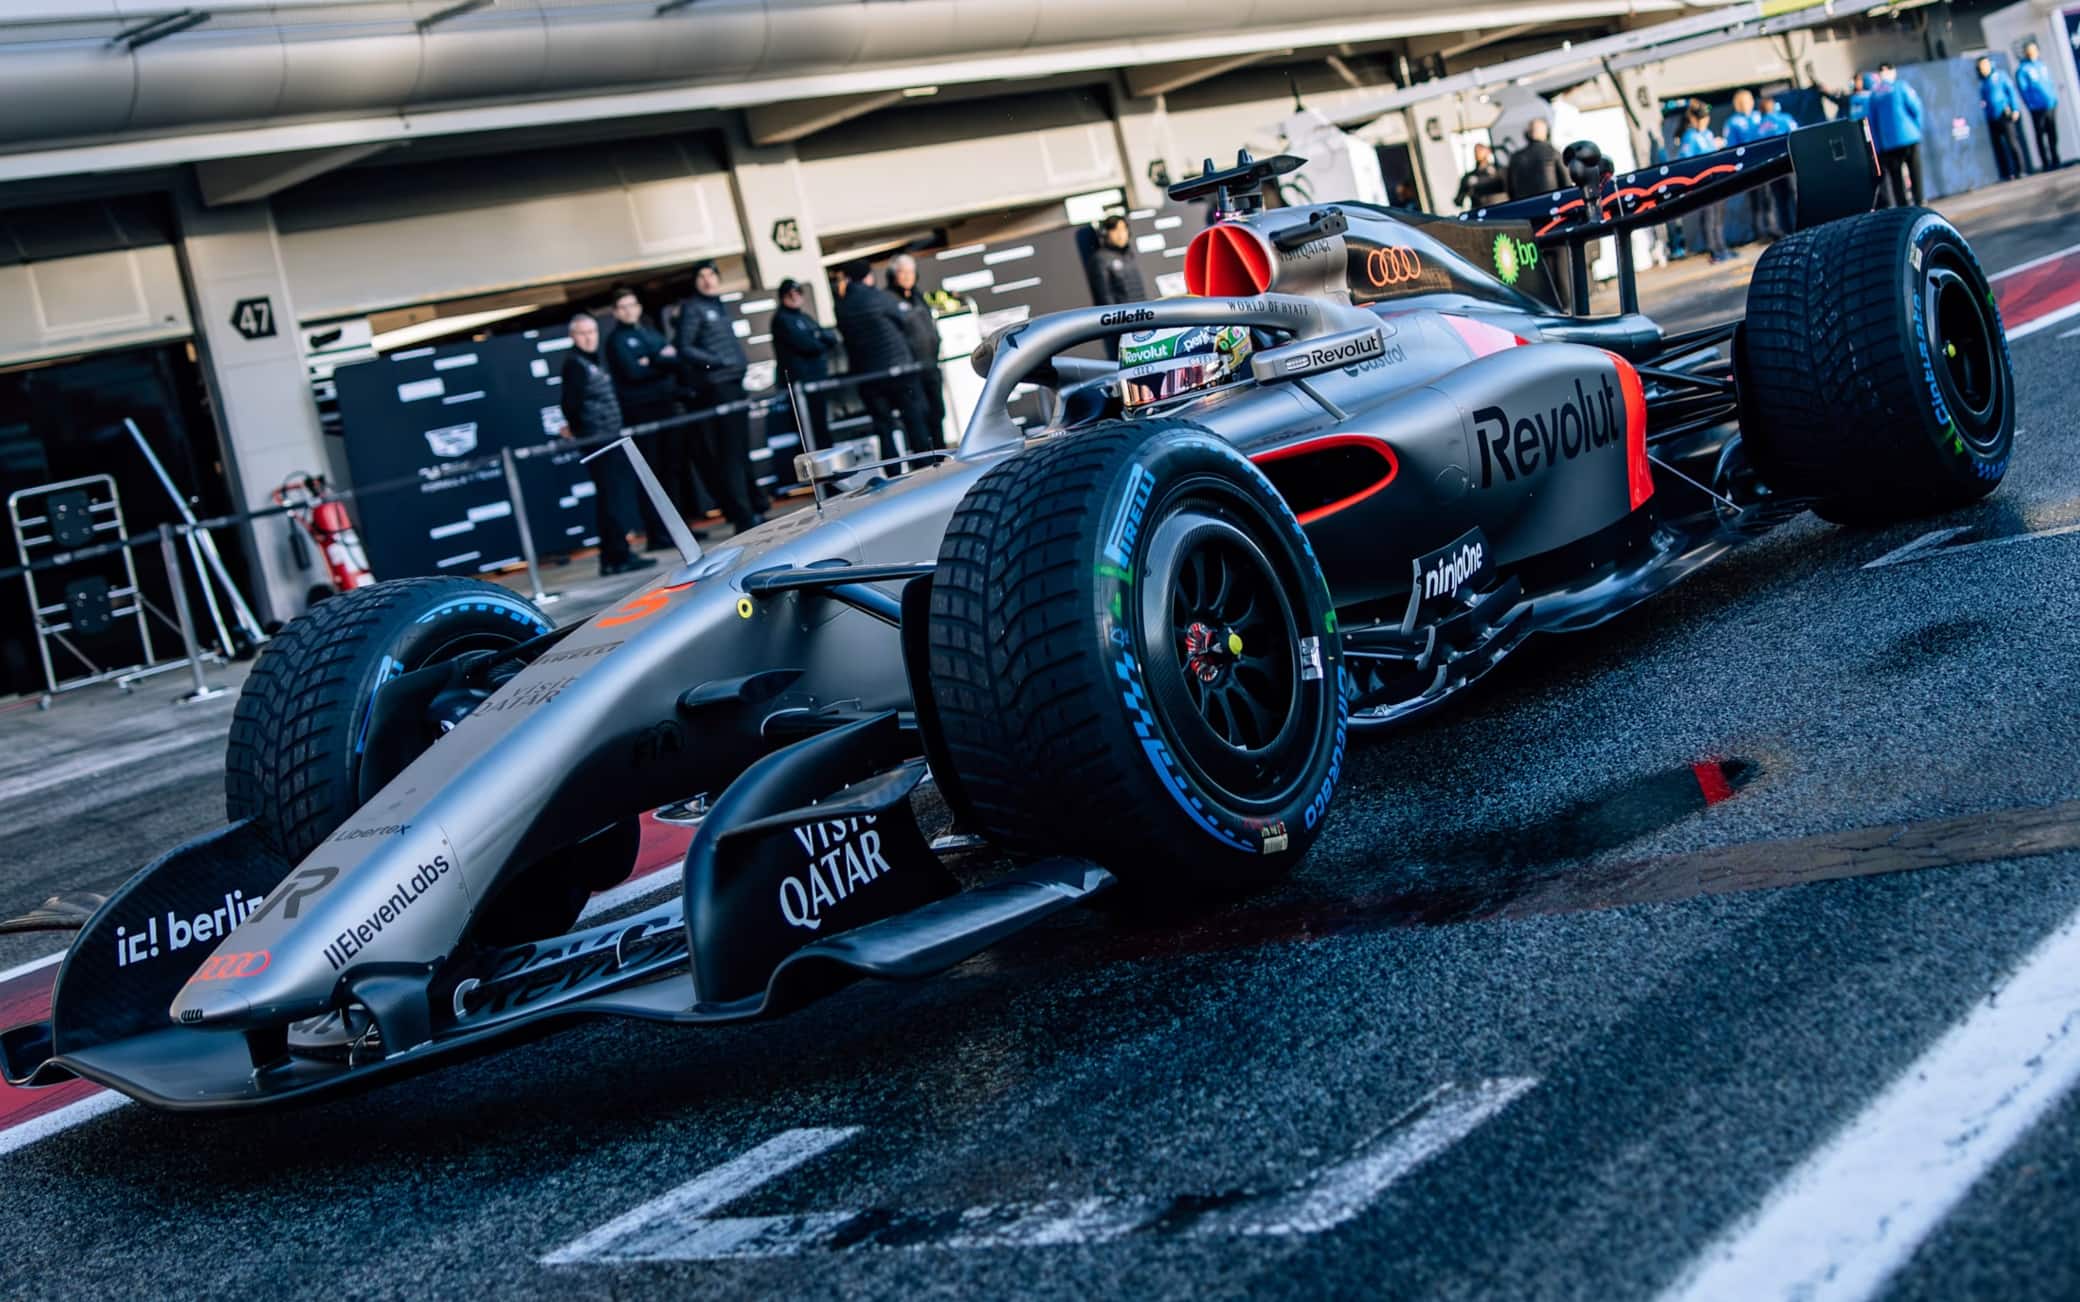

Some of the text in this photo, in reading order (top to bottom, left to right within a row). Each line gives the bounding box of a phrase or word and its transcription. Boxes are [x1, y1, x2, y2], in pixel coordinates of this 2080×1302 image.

[1516, 238, 1539, 271] bp
[240, 302, 271, 334] 47
[1101, 308, 1155, 326] Gillette
[1228, 300, 1265, 313] WORLD
[1124, 343, 1169, 364] Revolut
[1311, 336, 1378, 366] Revolut
[1472, 374, 1618, 489] Revolut
[1104, 463, 1156, 570] PIRELLI
[780, 830, 891, 930] QATAR
[116, 897, 160, 967] ic!
